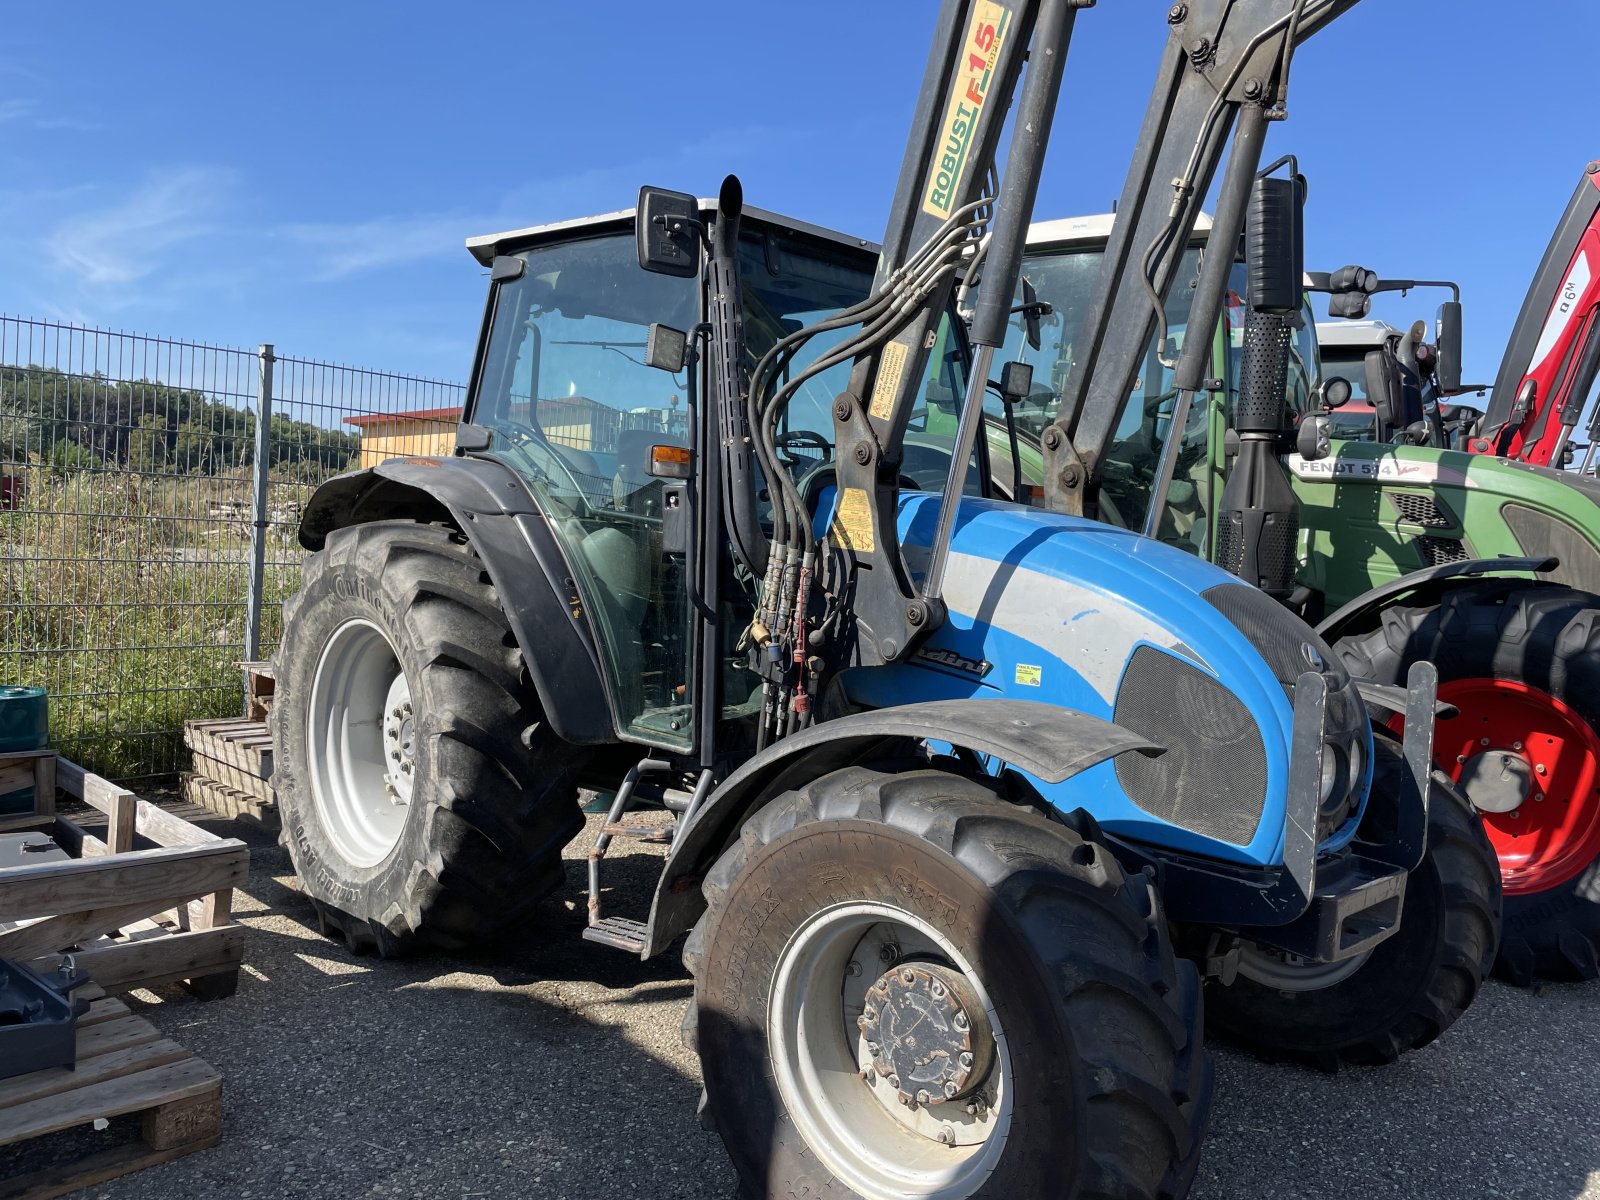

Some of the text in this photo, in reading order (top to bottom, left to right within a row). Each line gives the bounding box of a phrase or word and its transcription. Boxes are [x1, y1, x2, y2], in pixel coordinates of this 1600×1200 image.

[930, 102, 972, 209] ROBUST
[880, 348, 892, 382] Aufenthalt
[1300, 462, 1355, 474] FENDT
[1361, 464, 1392, 476] 514
[332, 572, 409, 659] Continental
